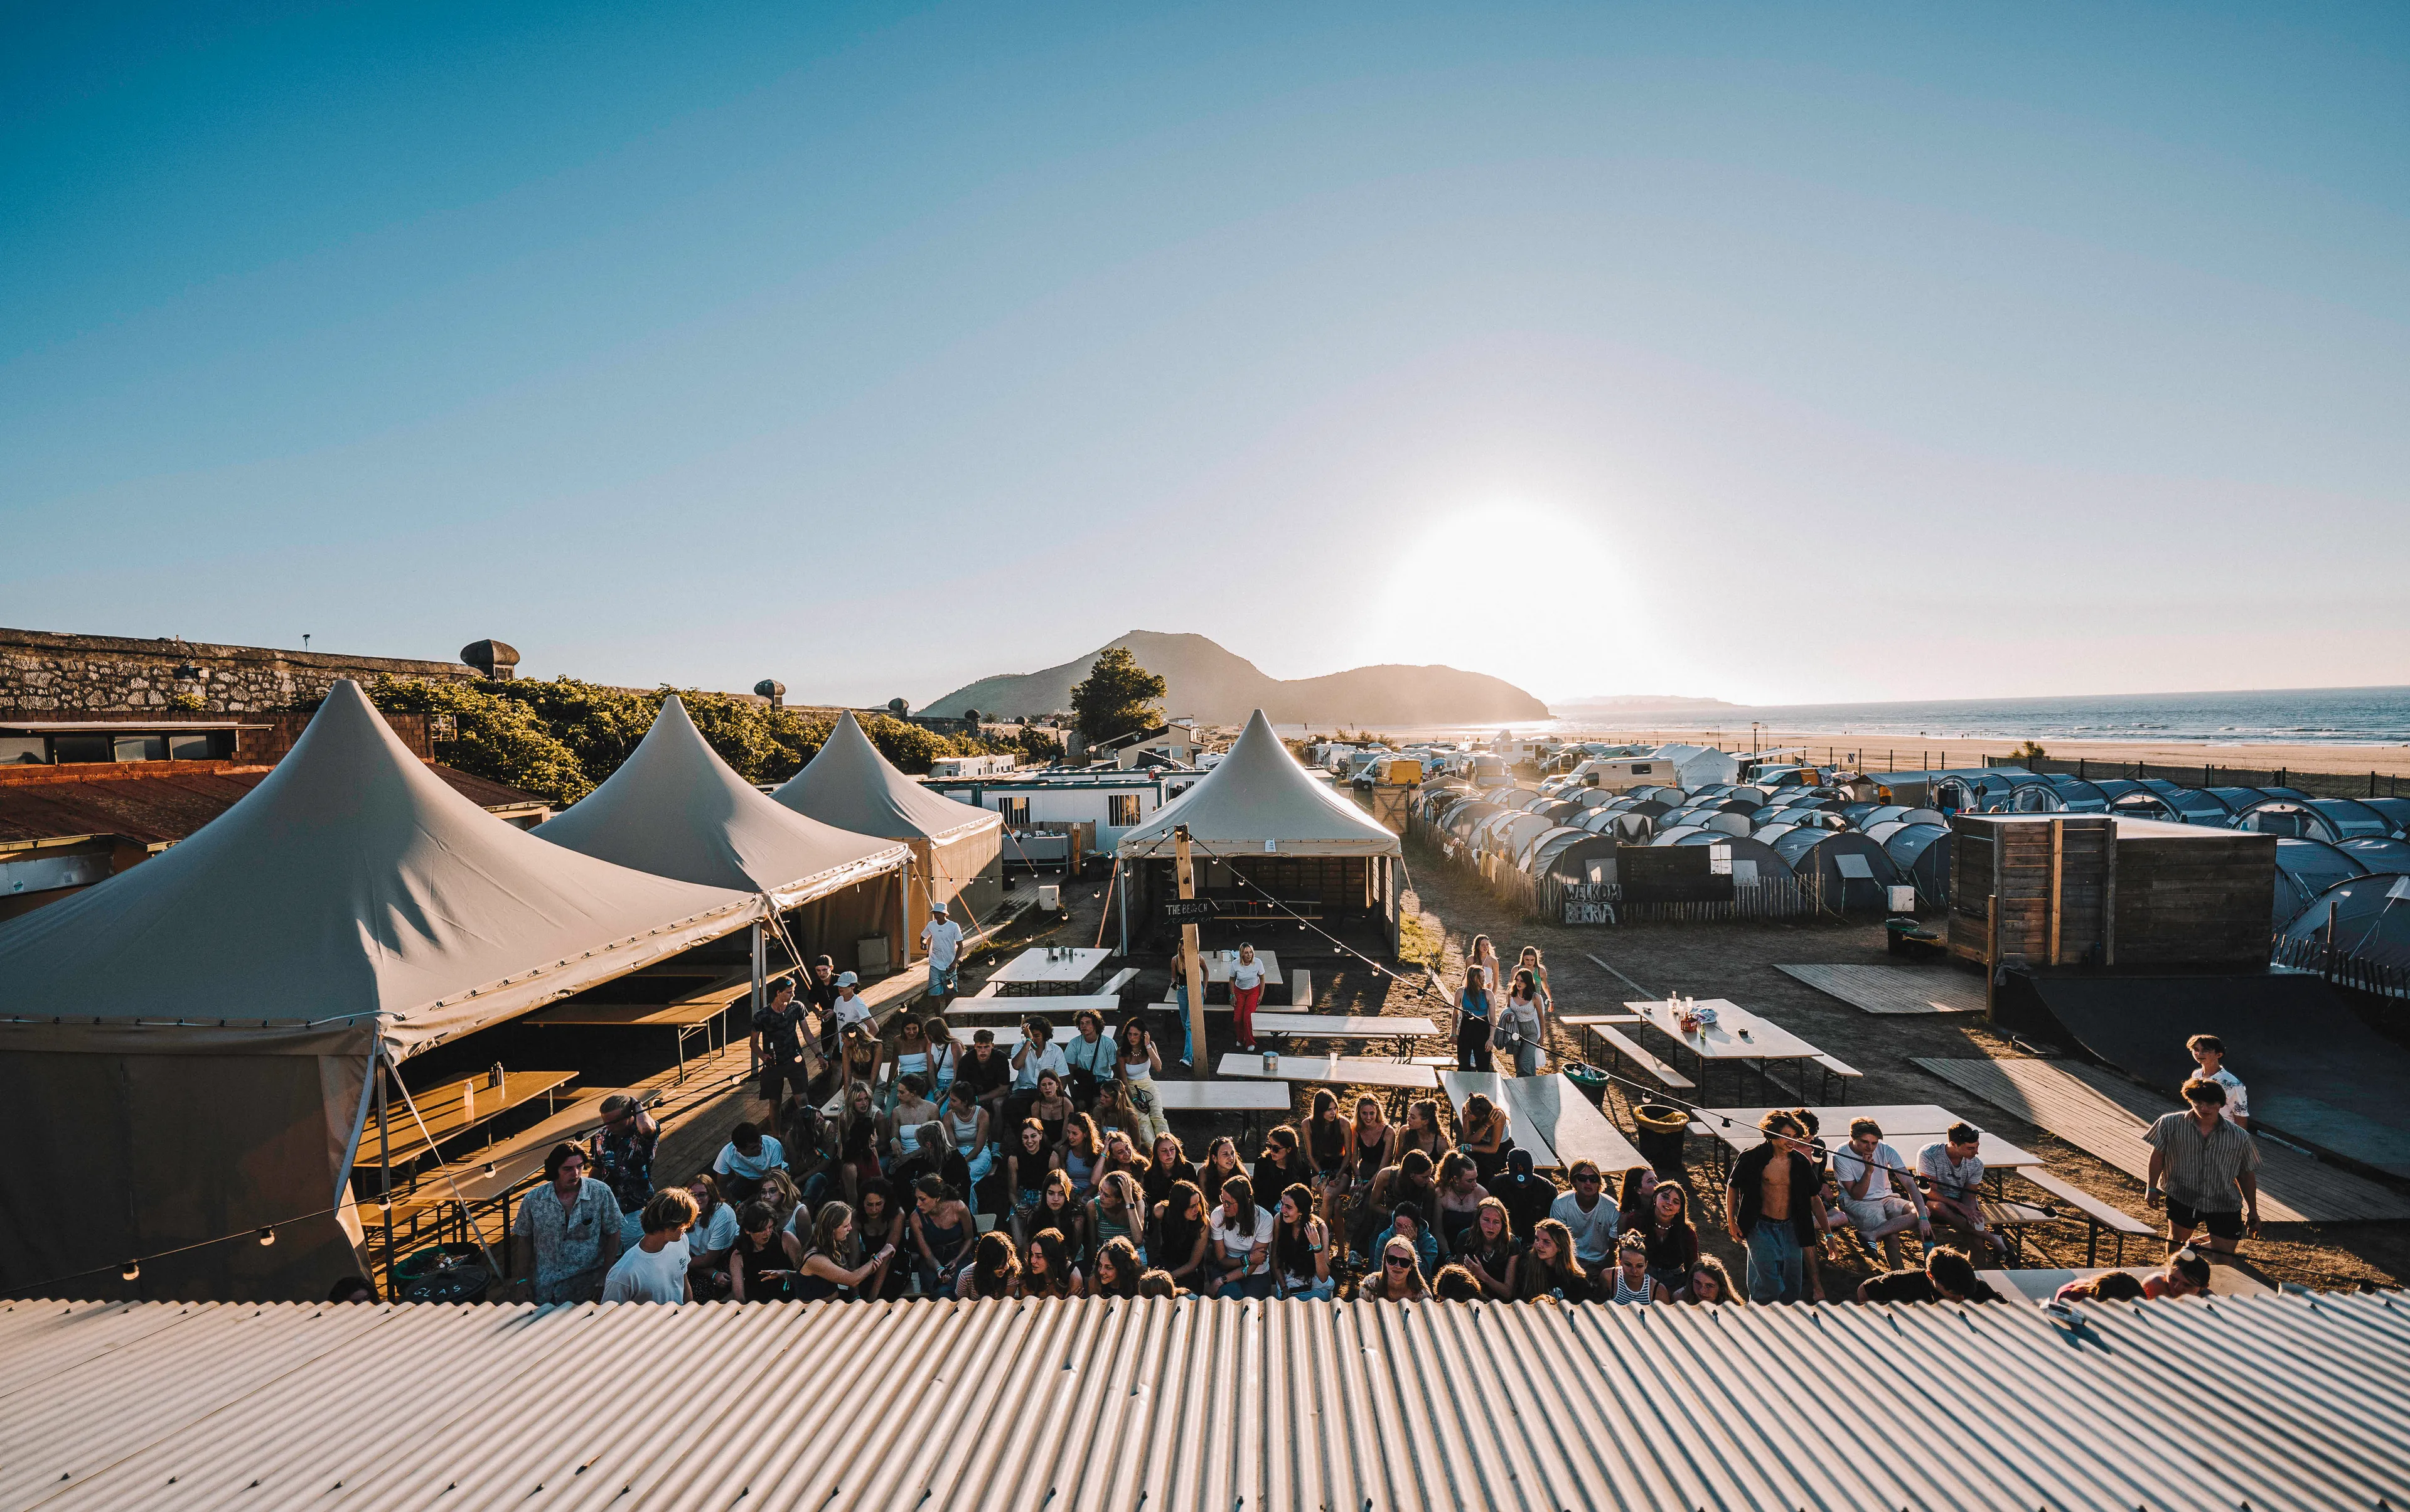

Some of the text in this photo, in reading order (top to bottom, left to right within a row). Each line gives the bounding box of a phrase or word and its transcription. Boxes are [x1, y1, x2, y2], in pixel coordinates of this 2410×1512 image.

[1563, 884, 1622, 901] WELKOM
[1165, 904, 1181, 915] THE
[1565, 903, 1616, 924] BERRIA
[414, 1285, 461, 1297] GLAS
